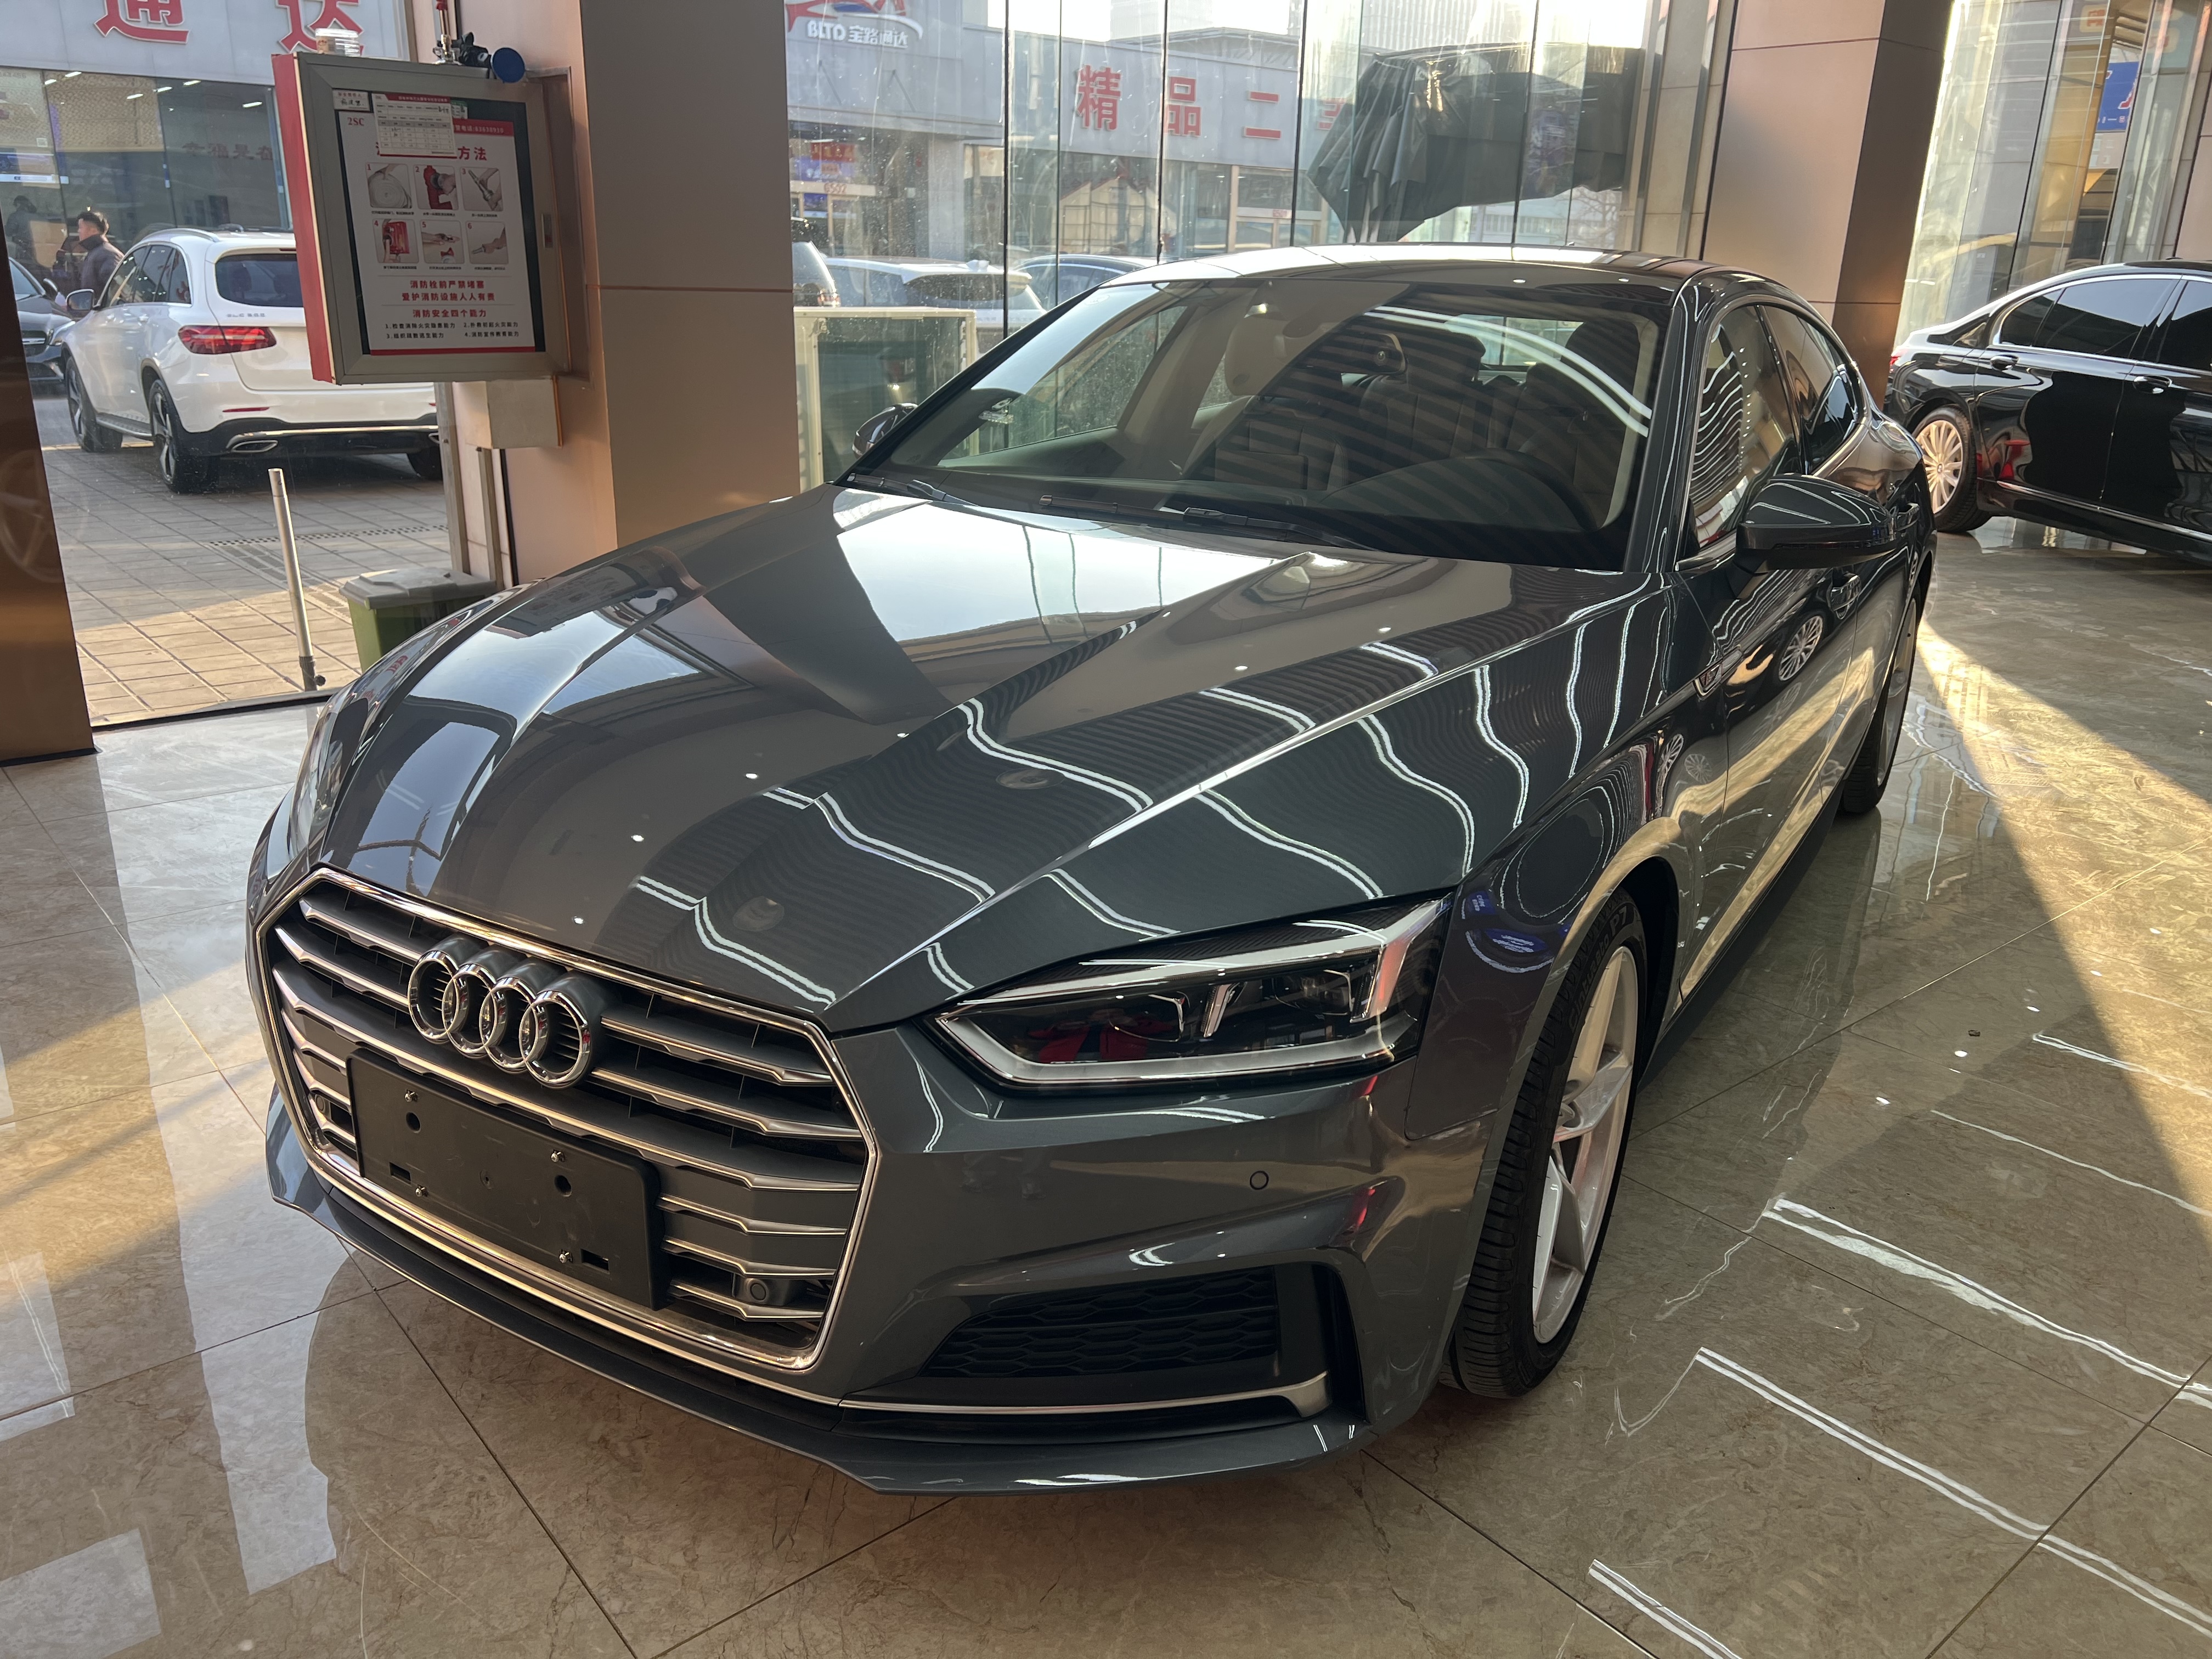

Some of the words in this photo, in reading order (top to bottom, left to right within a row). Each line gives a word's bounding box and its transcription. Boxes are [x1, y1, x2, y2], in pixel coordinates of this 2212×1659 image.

[807, 20, 847, 41] BLTD
[848, 25, 909, 49] 宝路通达
[347, 117, 365, 126] 2SC
[458, 146, 488, 161] 方法
[402, 292, 495, 301] 爱护消防设施人人有责
[413, 309, 487, 318] 消防安全四个能力
[1568, 934, 1610, 1035] Cinturato
[1610, 905, 1628, 937] P7
